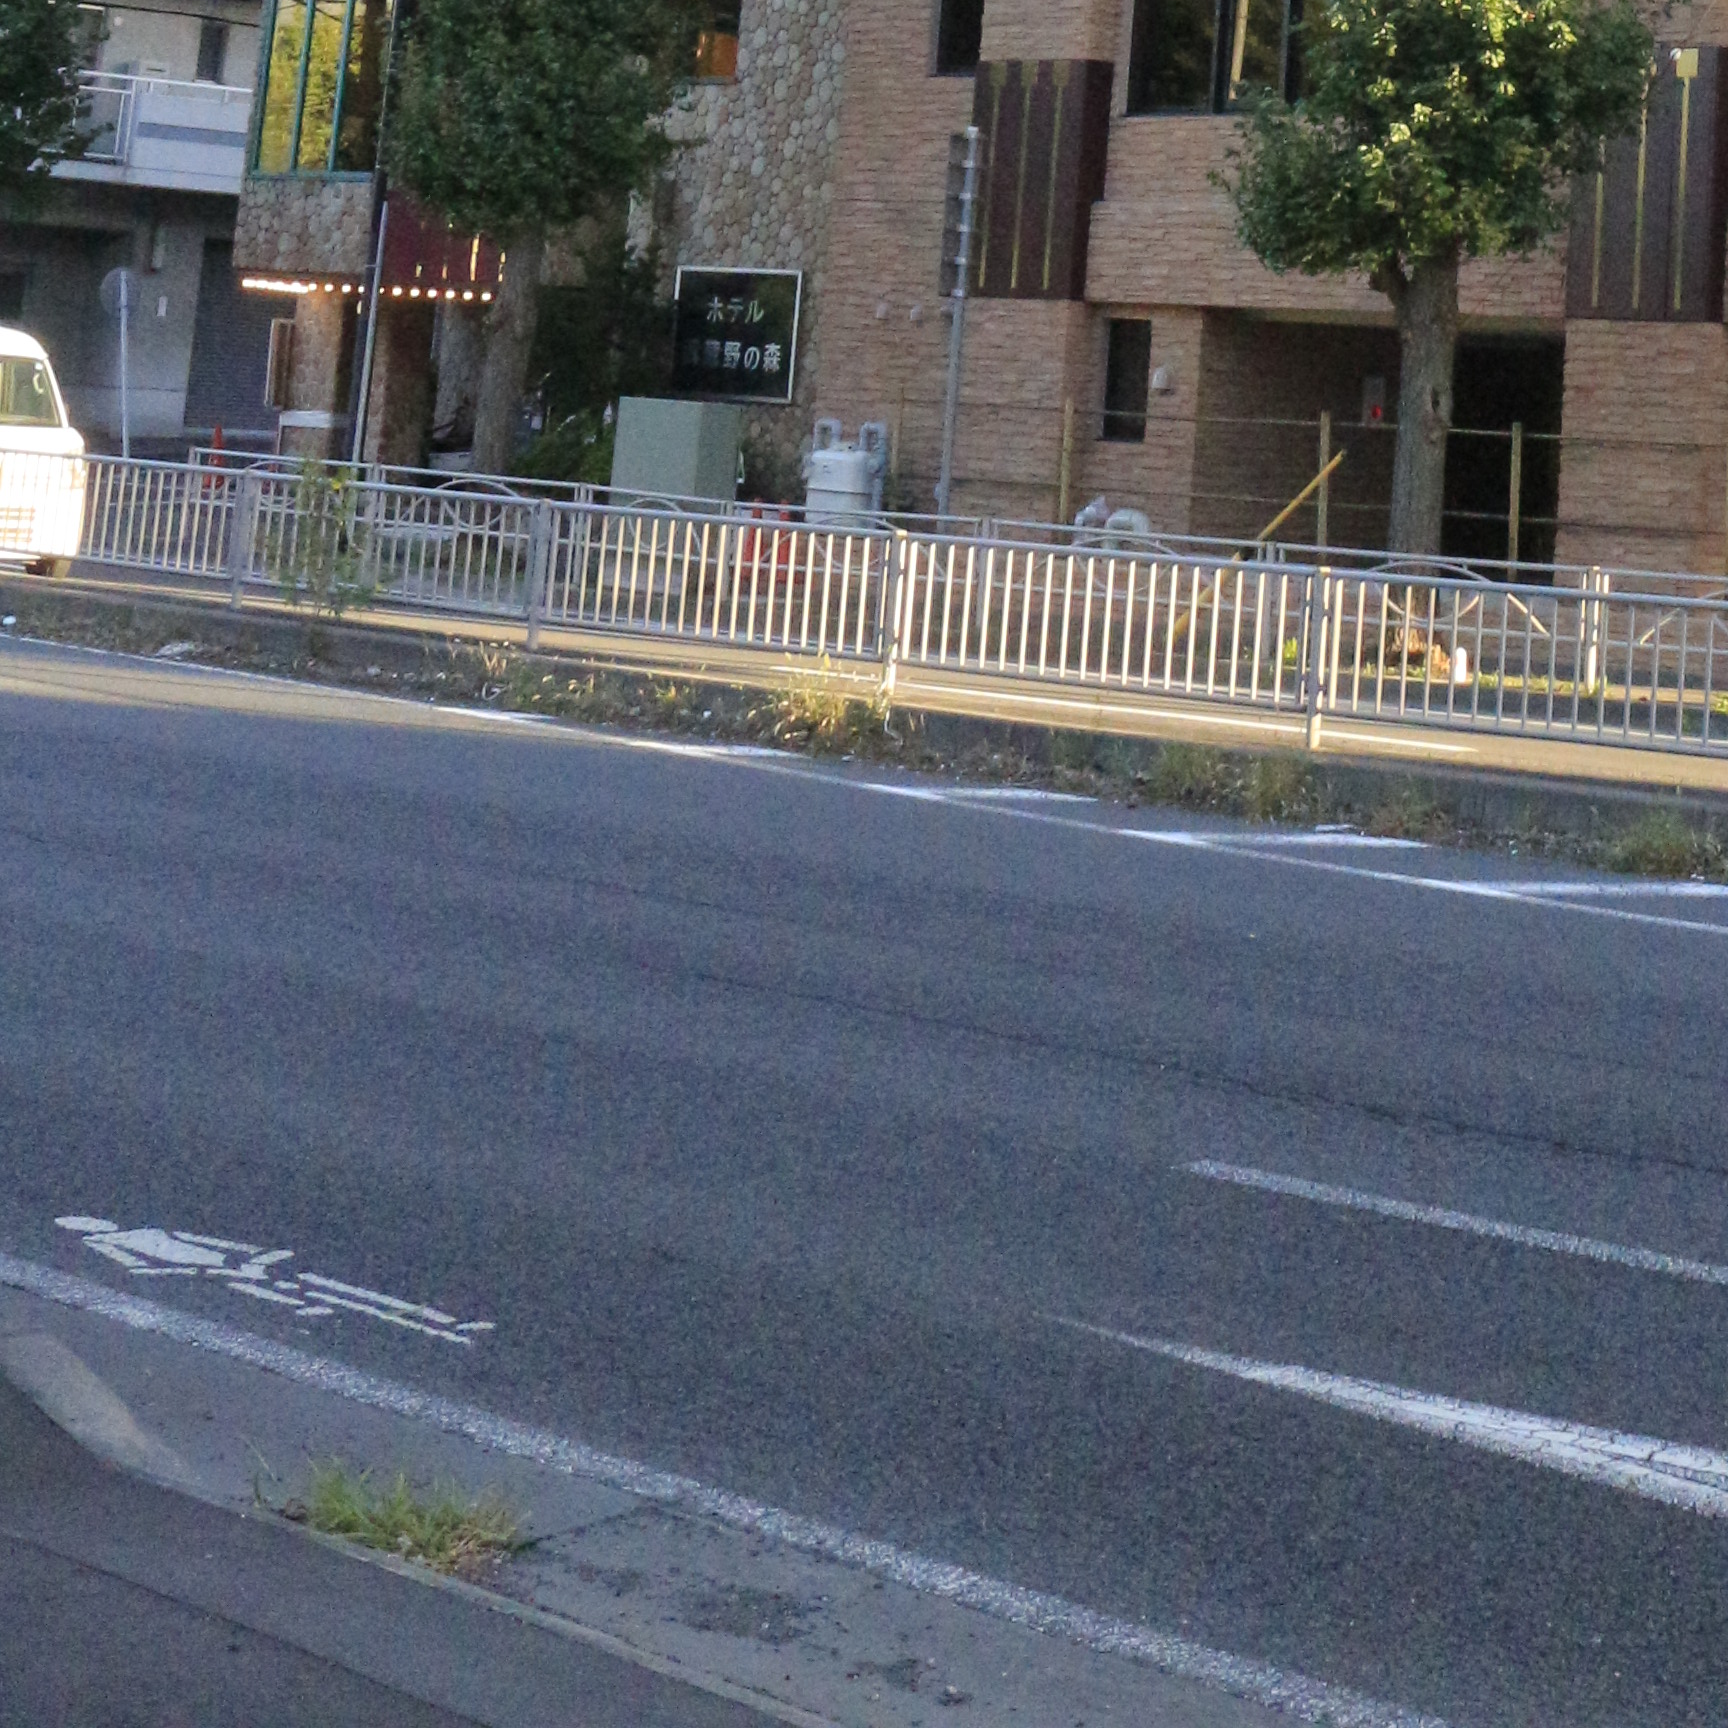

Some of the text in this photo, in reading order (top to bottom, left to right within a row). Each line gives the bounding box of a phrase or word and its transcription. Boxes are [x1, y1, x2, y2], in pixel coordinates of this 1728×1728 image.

[706, 296, 764, 323] ホテル
[685, 340, 781, 372] 野の森
